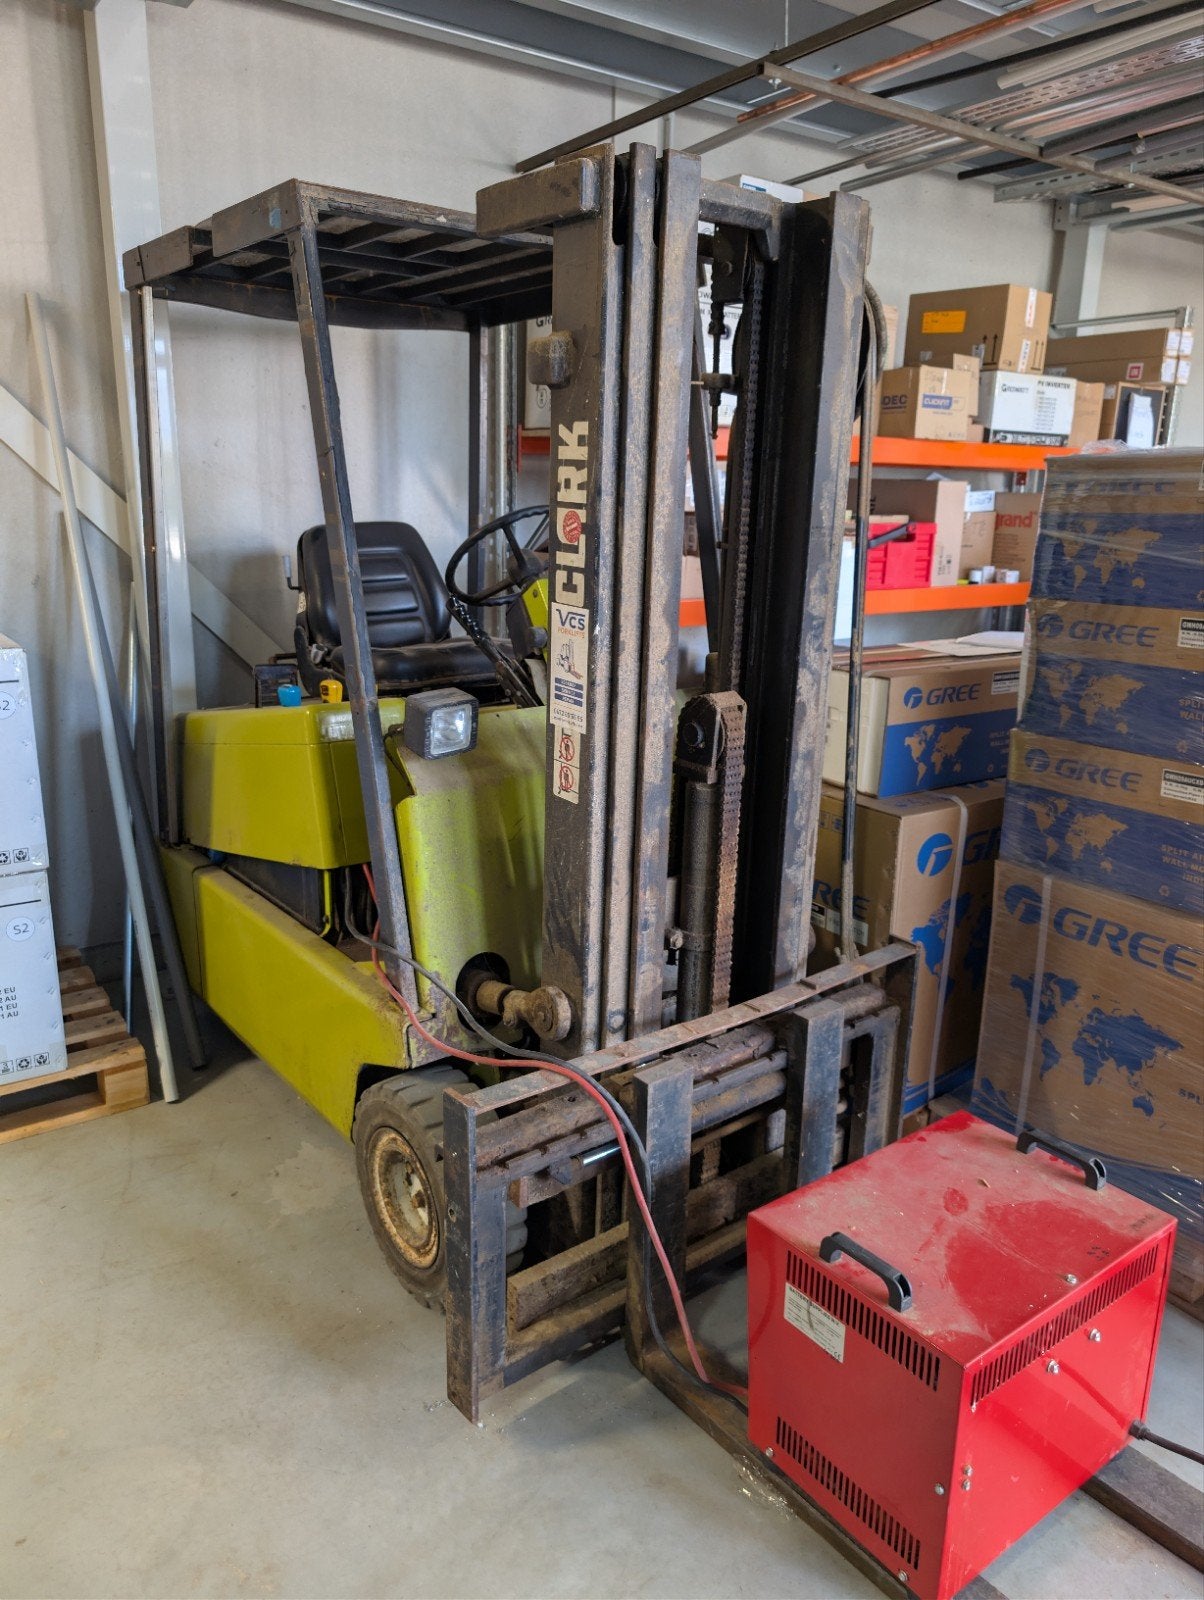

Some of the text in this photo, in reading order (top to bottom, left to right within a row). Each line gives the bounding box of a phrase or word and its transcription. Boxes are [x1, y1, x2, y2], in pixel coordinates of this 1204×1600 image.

[555, 420, 589, 608] CLARK
[996, 510, 1033, 528] rand
[556, 608, 586, 631] VCS
[1068, 620, 1160, 648] GREE
[0, 699, 10, 711] 2
[926, 683, 982, 706] GREE
[1055, 759, 1143, 793] GREE
[13, 923, 30, 935] S2
[1053, 907, 1204, 982] GREE
